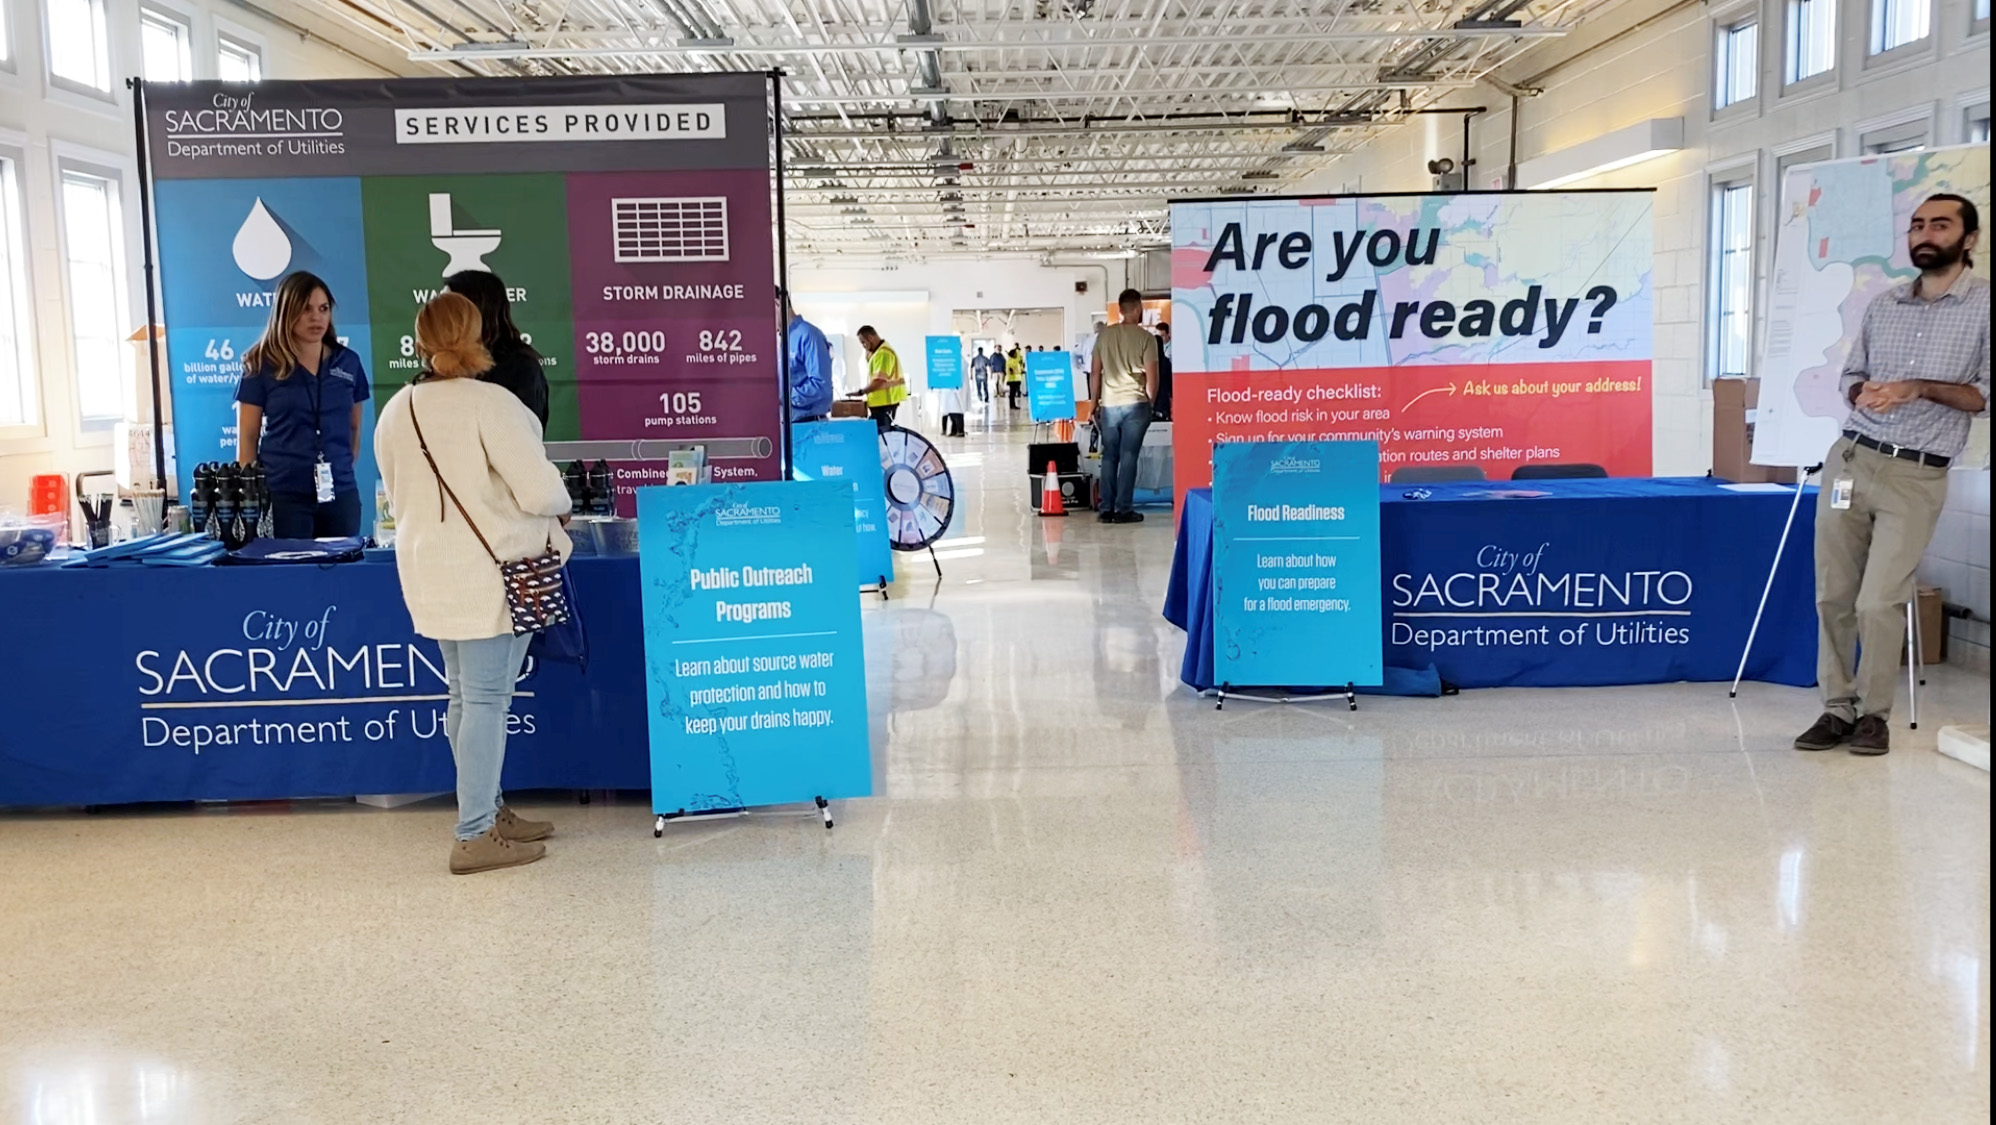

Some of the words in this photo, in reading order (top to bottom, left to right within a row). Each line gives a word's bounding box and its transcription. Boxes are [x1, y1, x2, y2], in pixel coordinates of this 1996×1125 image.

[213, 93, 239, 112] City
[240, 92, 255, 112] of
[165, 108, 343, 132] SACRAMENTO
[406, 115, 550, 135] SERVICES
[565, 112, 711, 133] PROVIDED
[167, 140, 262, 159] Department
[267, 139, 285, 155] of
[288, 138, 345, 154] Utilities
[1204, 220, 1313, 274] Are
[1326, 226, 1441, 282] you
[236, 292, 276, 307] WAT
[603, 286, 658, 300] STORM
[663, 285, 744, 300] DRAINAGE
[1207, 289, 1377, 345] flood
[1389, 284, 1618, 349] ready?
[205, 339, 235, 360] 46
[400, 335, 415, 356] 8
[586, 331, 666, 356] 38,000
[699, 330, 742, 351] 842
[184, 361, 217, 373] billion
[389, 357, 419, 369] miles
[593, 356, 624, 365] storm
[627, 355, 660, 365] drains
[686, 353, 715, 363] miles
[717, 352, 728, 362] of
[730, 353, 757, 364] pipes
[186, 374, 197, 384] of
[198, 372, 240, 385] water/y
[1463, 380, 1491, 396] Ask
[1493, 383, 1508, 395] us
[1511, 378, 1549, 395] about
[1551, 380, 1582, 397] your
[1585, 376, 1642, 393] address!
[660, 393, 701, 414] 105
[1207, 385, 1302, 404] Flood-ready
[1306, 383, 1382, 400] checklist:
[645, 417, 673, 428] pump
[676, 415, 717, 426] stations
[1216, 411, 1253, 424] Know
[1256, 409, 1288, 423] flood
[1291, 408, 1314, 422] risk
[1316, 408, 1328, 421] in
[1331, 409, 1360, 424] your
[1363, 408, 1390, 420] area
[1267, 431, 1285, 442] for
[1288, 432, 1316, 443] your
[1319, 428, 1401, 444] community's
[1404, 426, 1455, 442] warning
[1458, 426, 1503, 441] system
[1410, 450, 1449, 462] routes
[1452, 447, 1476, 461] and
[1480, 446, 1522, 460] shelter
[1526, 446, 1560, 461] plans
[714, 466, 758, 478] System,
[715, 506, 781, 517] SACRAMENTO
[1248, 504, 1280, 521] Flood
[1283, 503, 1345, 521] Readiness
[1257, 553, 1284, 568] Learn
[1286, 553, 1314, 568] about
[1316, 553, 1336, 567] how
[1476, 544, 1519, 576] City
[1522, 543, 1550, 576] of
[690, 567, 740, 590] Public
[742, 563, 813, 588] Outreach
[1258, 577, 1276, 591] you
[1278, 577, 1296, 590] can
[1298, 576, 1336, 591] prepare
[1392, 571, 1692, 607] SACRAMENTO
[716, 600, 792, 624] Programs
[1244, 597, 1257, 611] for
[1259, 600, 1266, 611] a
[1268, 597, 1292, 611] flood
[1294, 598, 1351, 613] emergency.
[242, 609, 298, 651] City
[304, 605, 337, 651] of
[1392, 622, 1549, 652] Department
[1559, 622, 1589, 645] of
[1596, 620, 1689, 645] Utilities
[136, 644, 535, 695] SACRAMEN
[675, 658, 711, 677] Learn
[713, 656, 750, 676] about
[753, 654, 797, 672] source
[799, 651, 834, 670] water
[690, 684, 755, 706] protection
[758, 682, 782, 700] and
[784, 680, 811, 698] how
[813, 679, 826, 697] to
[685, 715, 717, 735] keep
[719, 714, 747, 734] your
[751, 709, 791, 729] drains
[793, 707, 834, 728] happy.
[142, 715, 351, 754] Department
[364, 710, 400, 742] of
